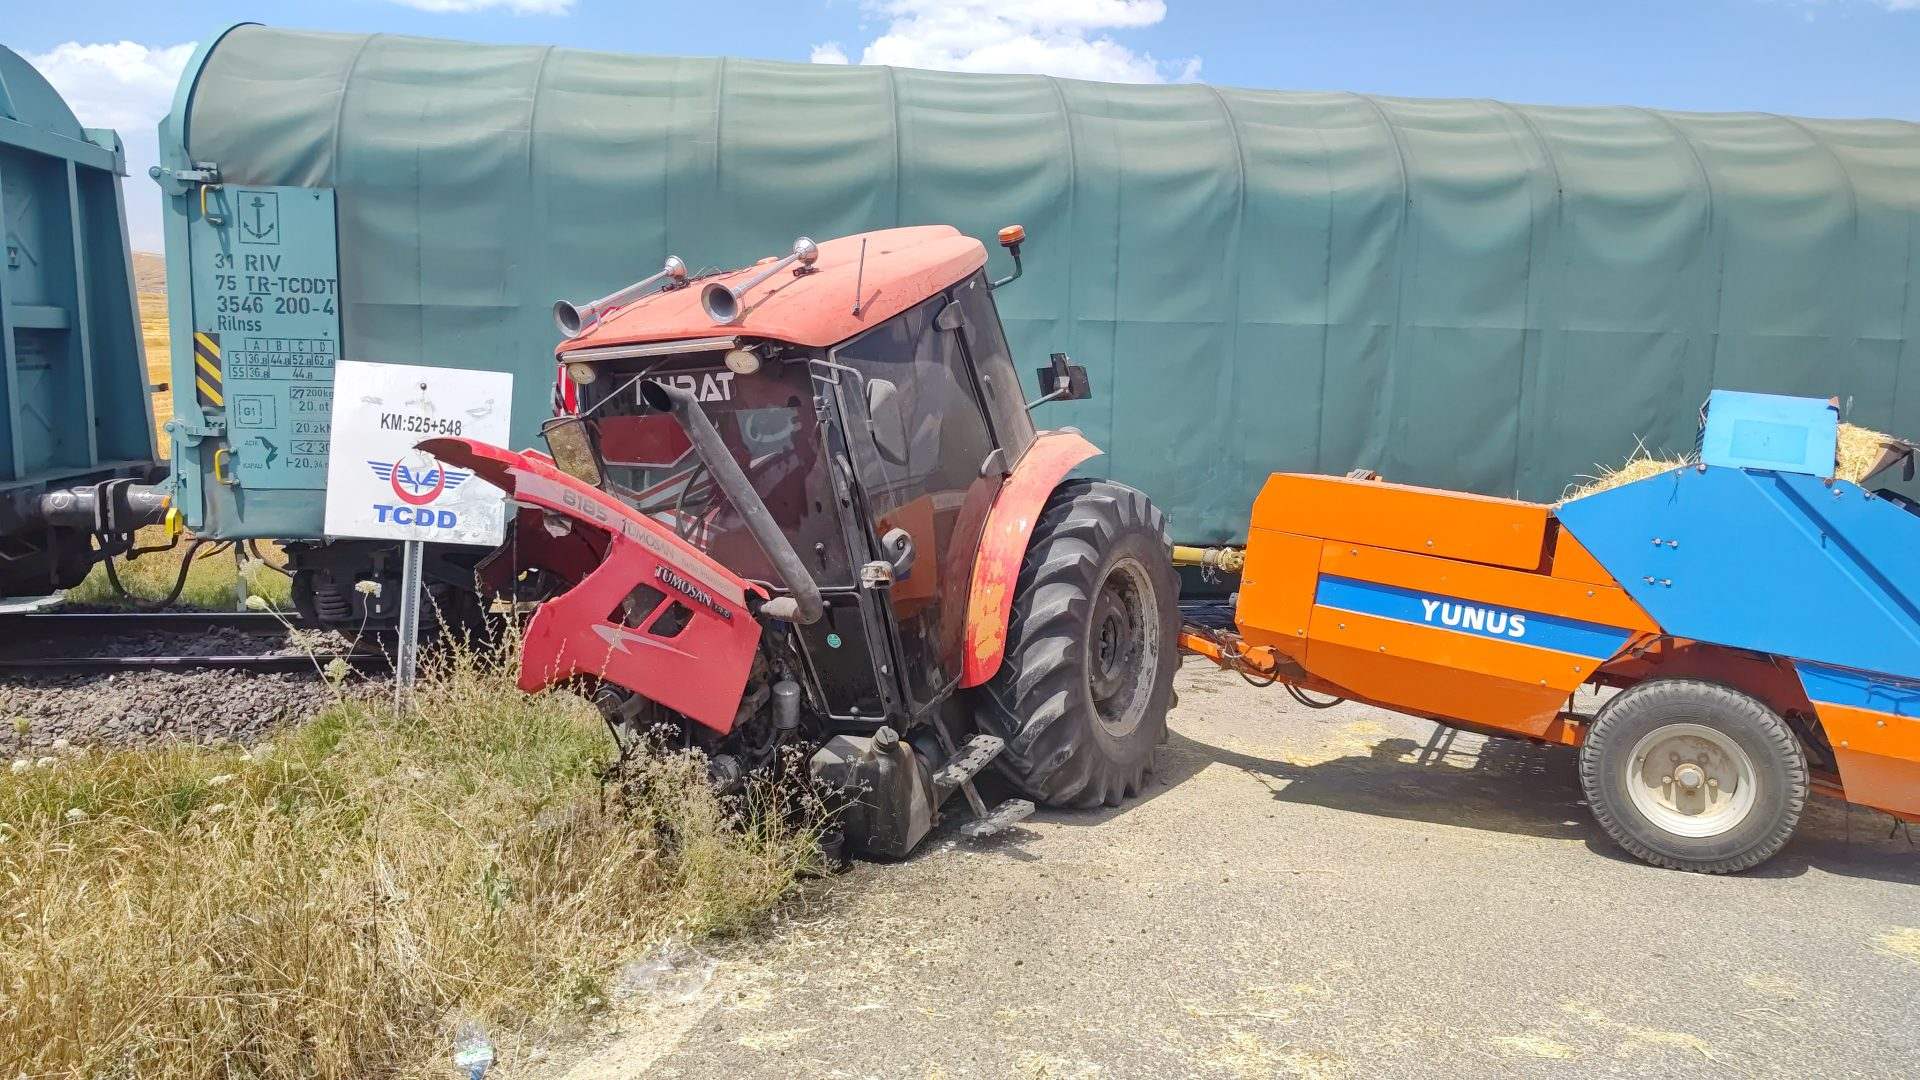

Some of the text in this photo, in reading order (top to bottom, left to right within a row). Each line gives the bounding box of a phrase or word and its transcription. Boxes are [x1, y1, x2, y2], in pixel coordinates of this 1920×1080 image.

[215, 253, 281, 272] 31 RIV
[215, 275, 337, 295] 75 TR-TCDDT
[216, 296, 334, 316] 3546 200-4
[217, 315, 262, 332] Rilnss
[253, 340, 326, 352] A B C D
[234, 353, 241, 364] S
[232, 367, 245, 377] SS
[635, 371, 735, 406] RAT
[380, 413, 462, 436] KM:525+548
[373, 504, 457, 529] TCDD
[1421, 598, 1526, 638] YUNUS
